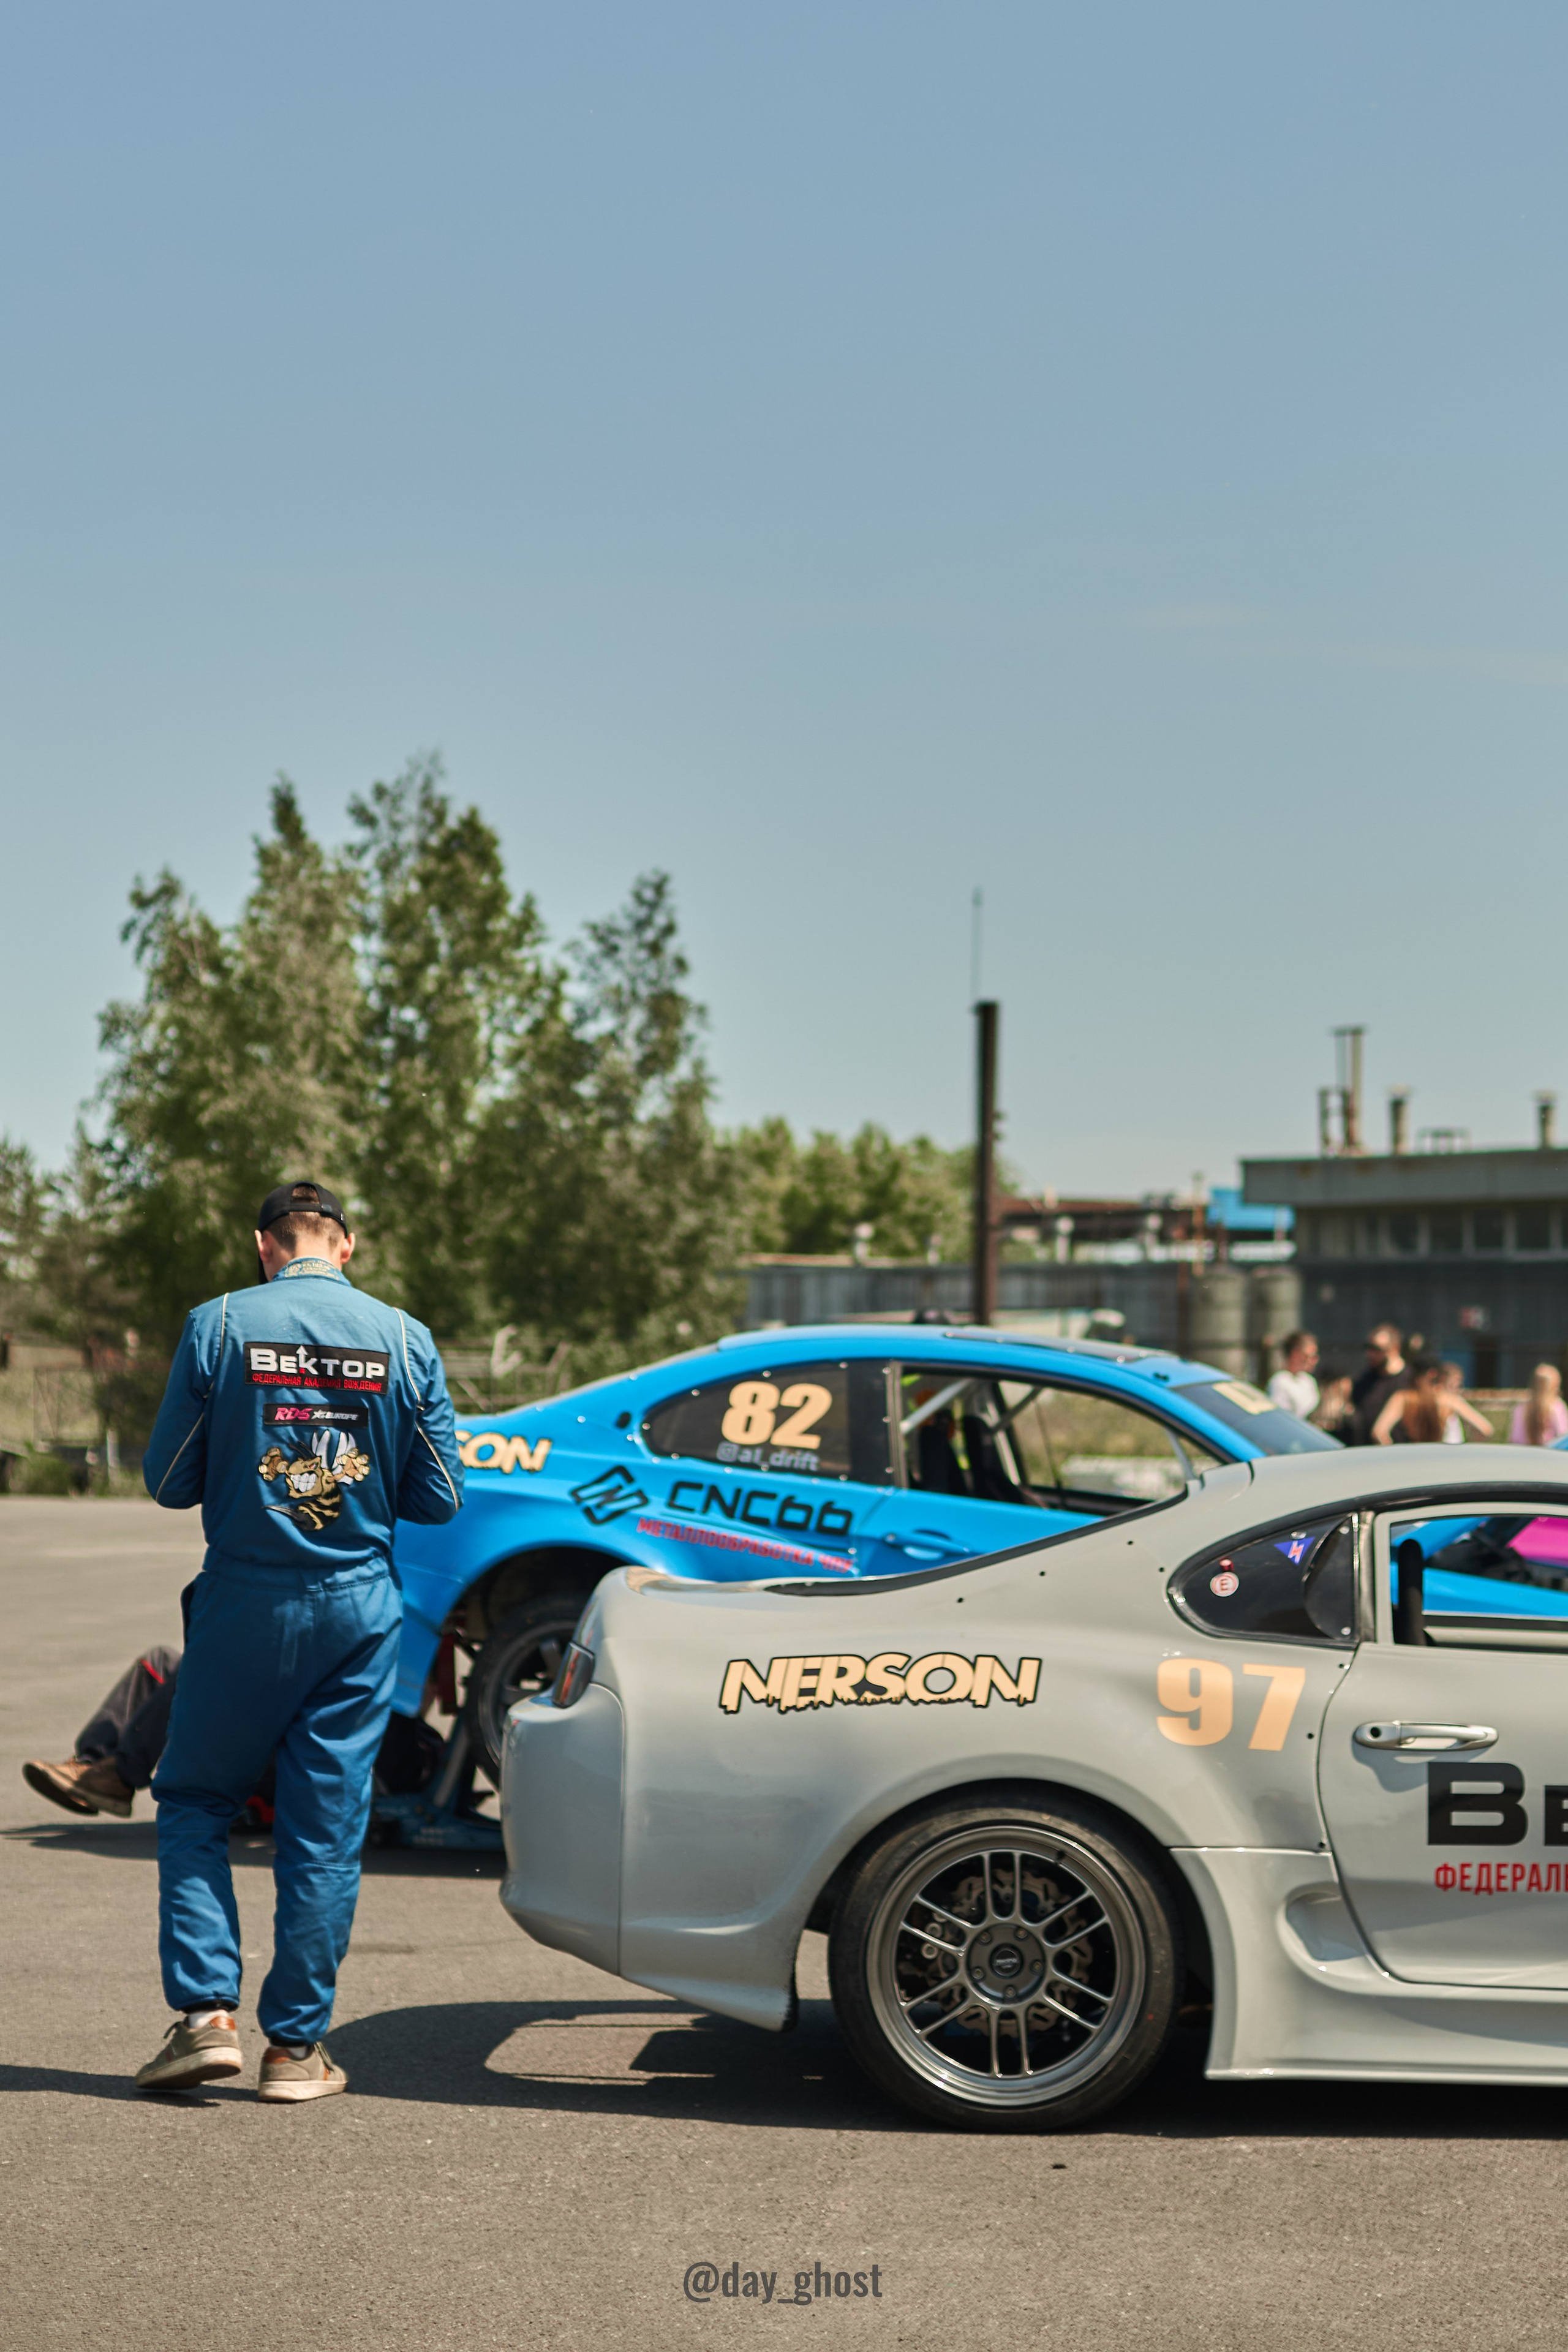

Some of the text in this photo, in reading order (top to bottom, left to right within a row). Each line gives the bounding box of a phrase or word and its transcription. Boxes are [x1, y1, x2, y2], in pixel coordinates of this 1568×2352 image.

[252, 1373, 382, 1392] ФЕДЕРАЛЬНАЯ АКАДЕМИЯ ВОЖДЕНИЯ
[274, 1408, 313, 1420] RDS
[722, 1381, 832, 1450] 82
[636, 1517, 814, 1566] МЕТАЛЛООБРАБОТКА
[718, 1652, 1042, 1714] NERSON
[1156, 1658, 1306, 1751] 97
